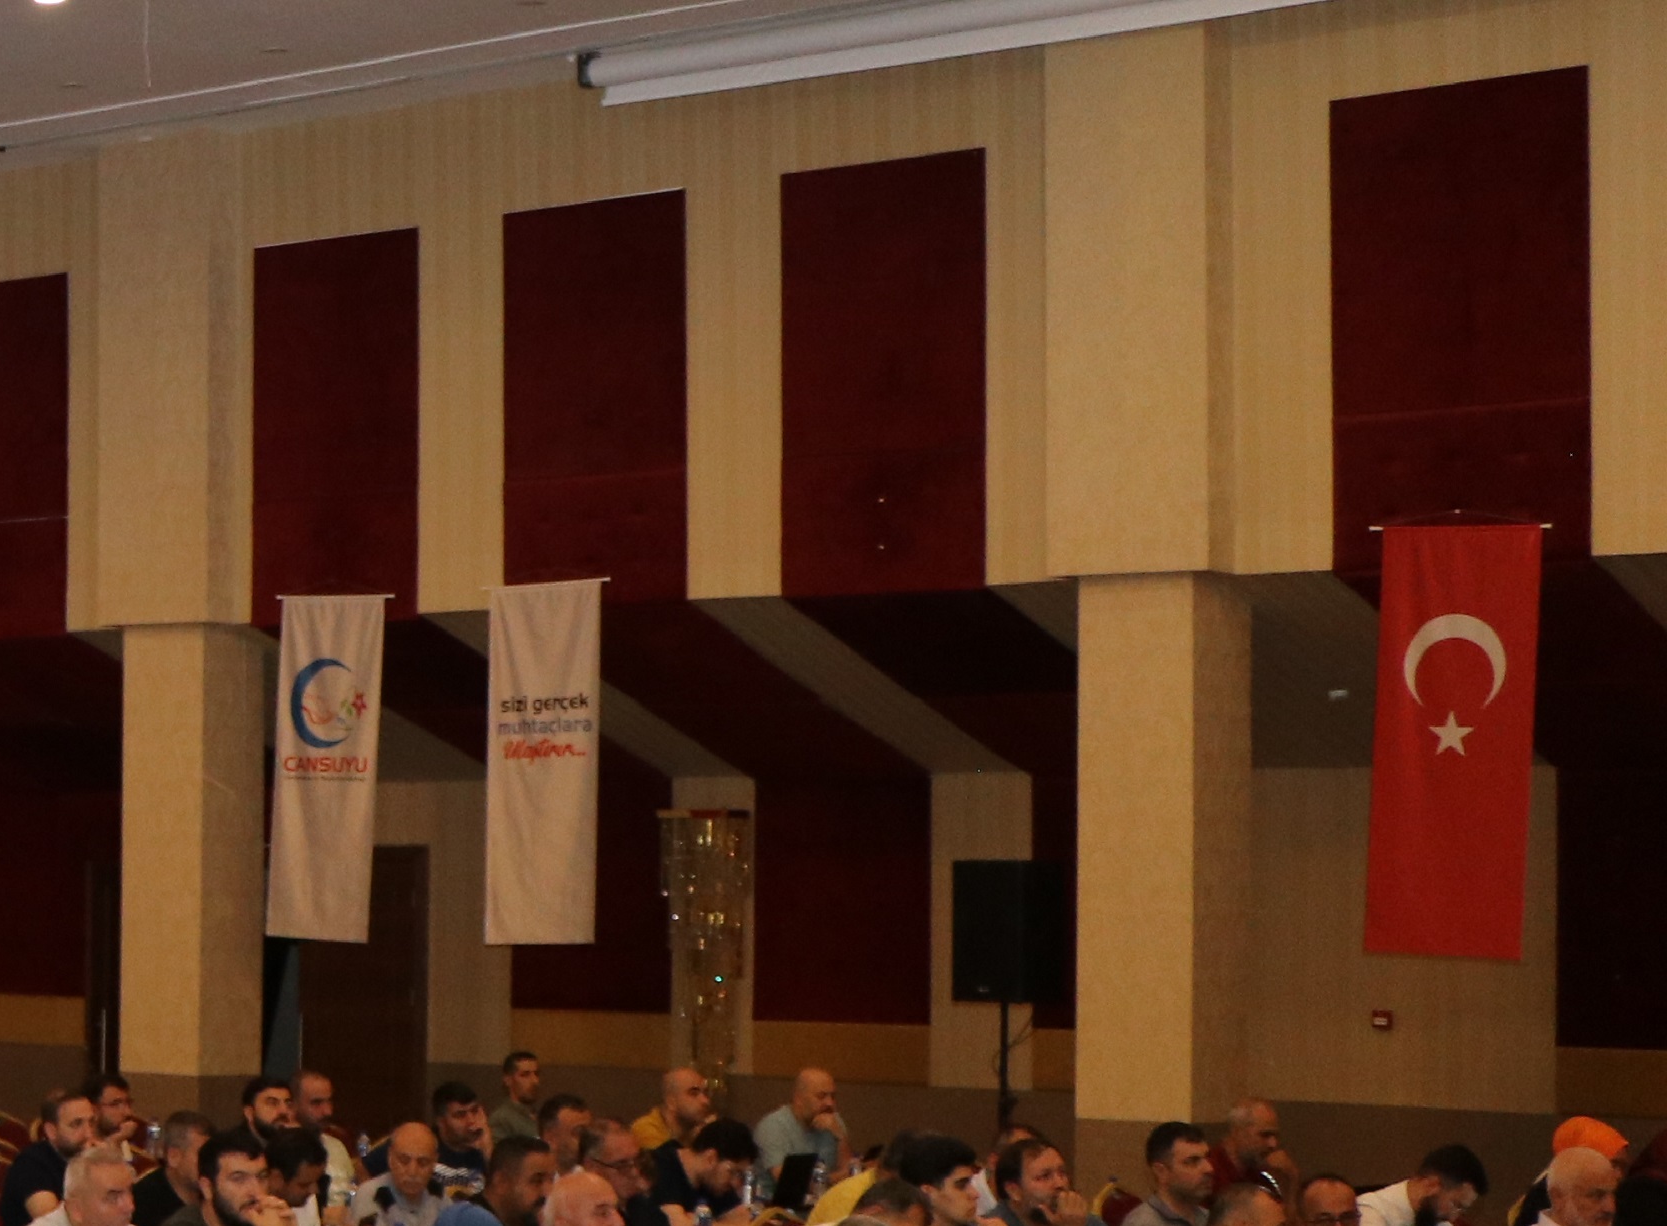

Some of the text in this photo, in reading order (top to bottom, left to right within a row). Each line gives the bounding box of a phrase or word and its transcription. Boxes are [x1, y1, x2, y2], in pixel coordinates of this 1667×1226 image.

[501, 692, 589, 715] sizi gerçek
[284, 756, 368, 773] CANSUYU
